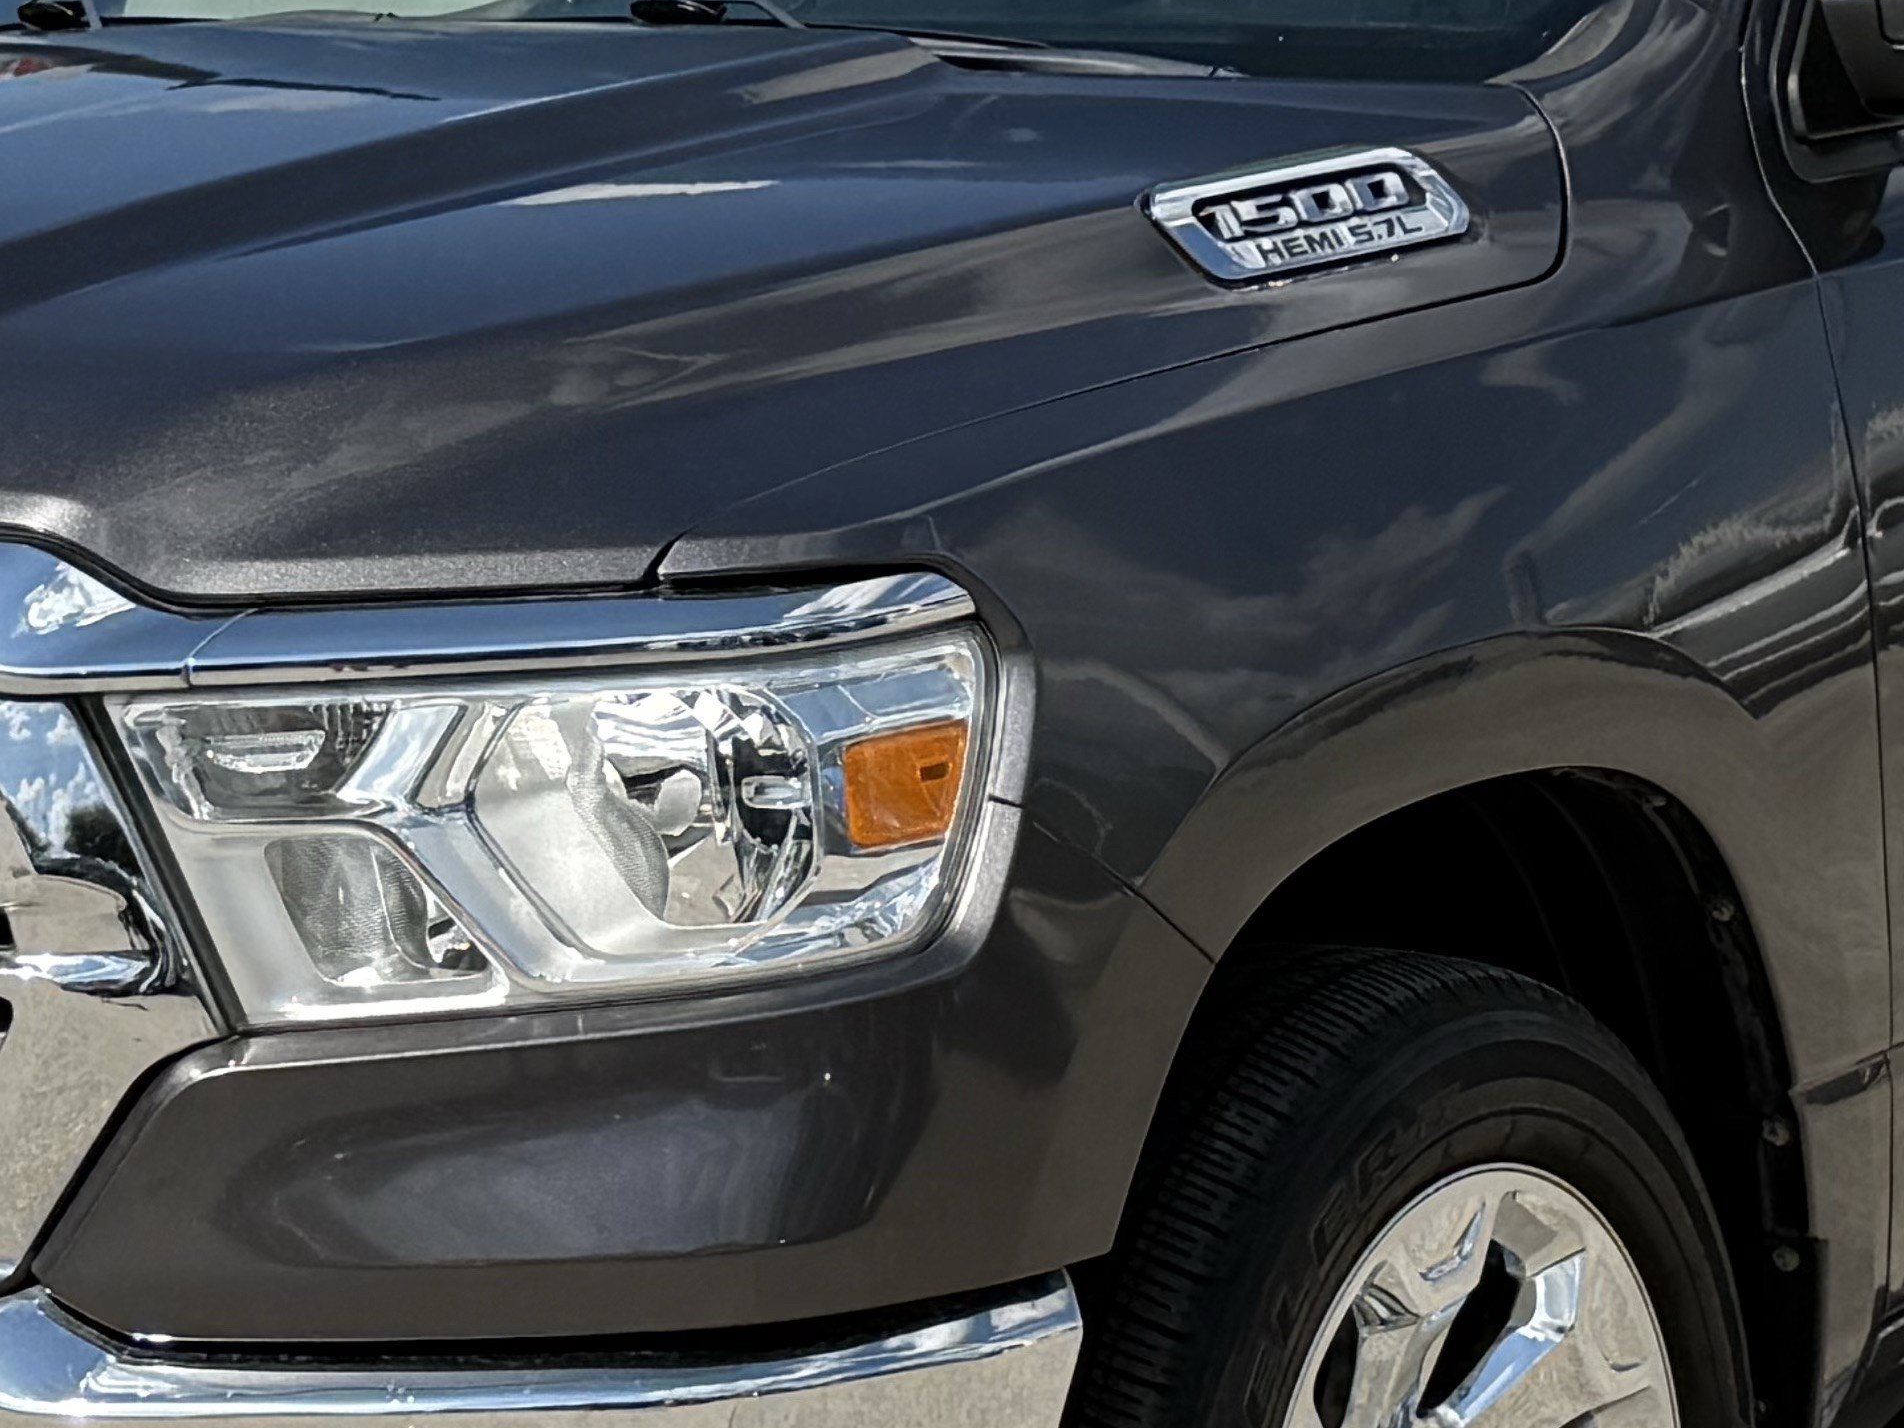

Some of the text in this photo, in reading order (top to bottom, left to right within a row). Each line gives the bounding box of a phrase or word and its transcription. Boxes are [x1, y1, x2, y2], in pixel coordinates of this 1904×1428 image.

[1204, 170, 1410, 241] 1500
[1256, 214, 1424, 267] HEMI 5.7L
